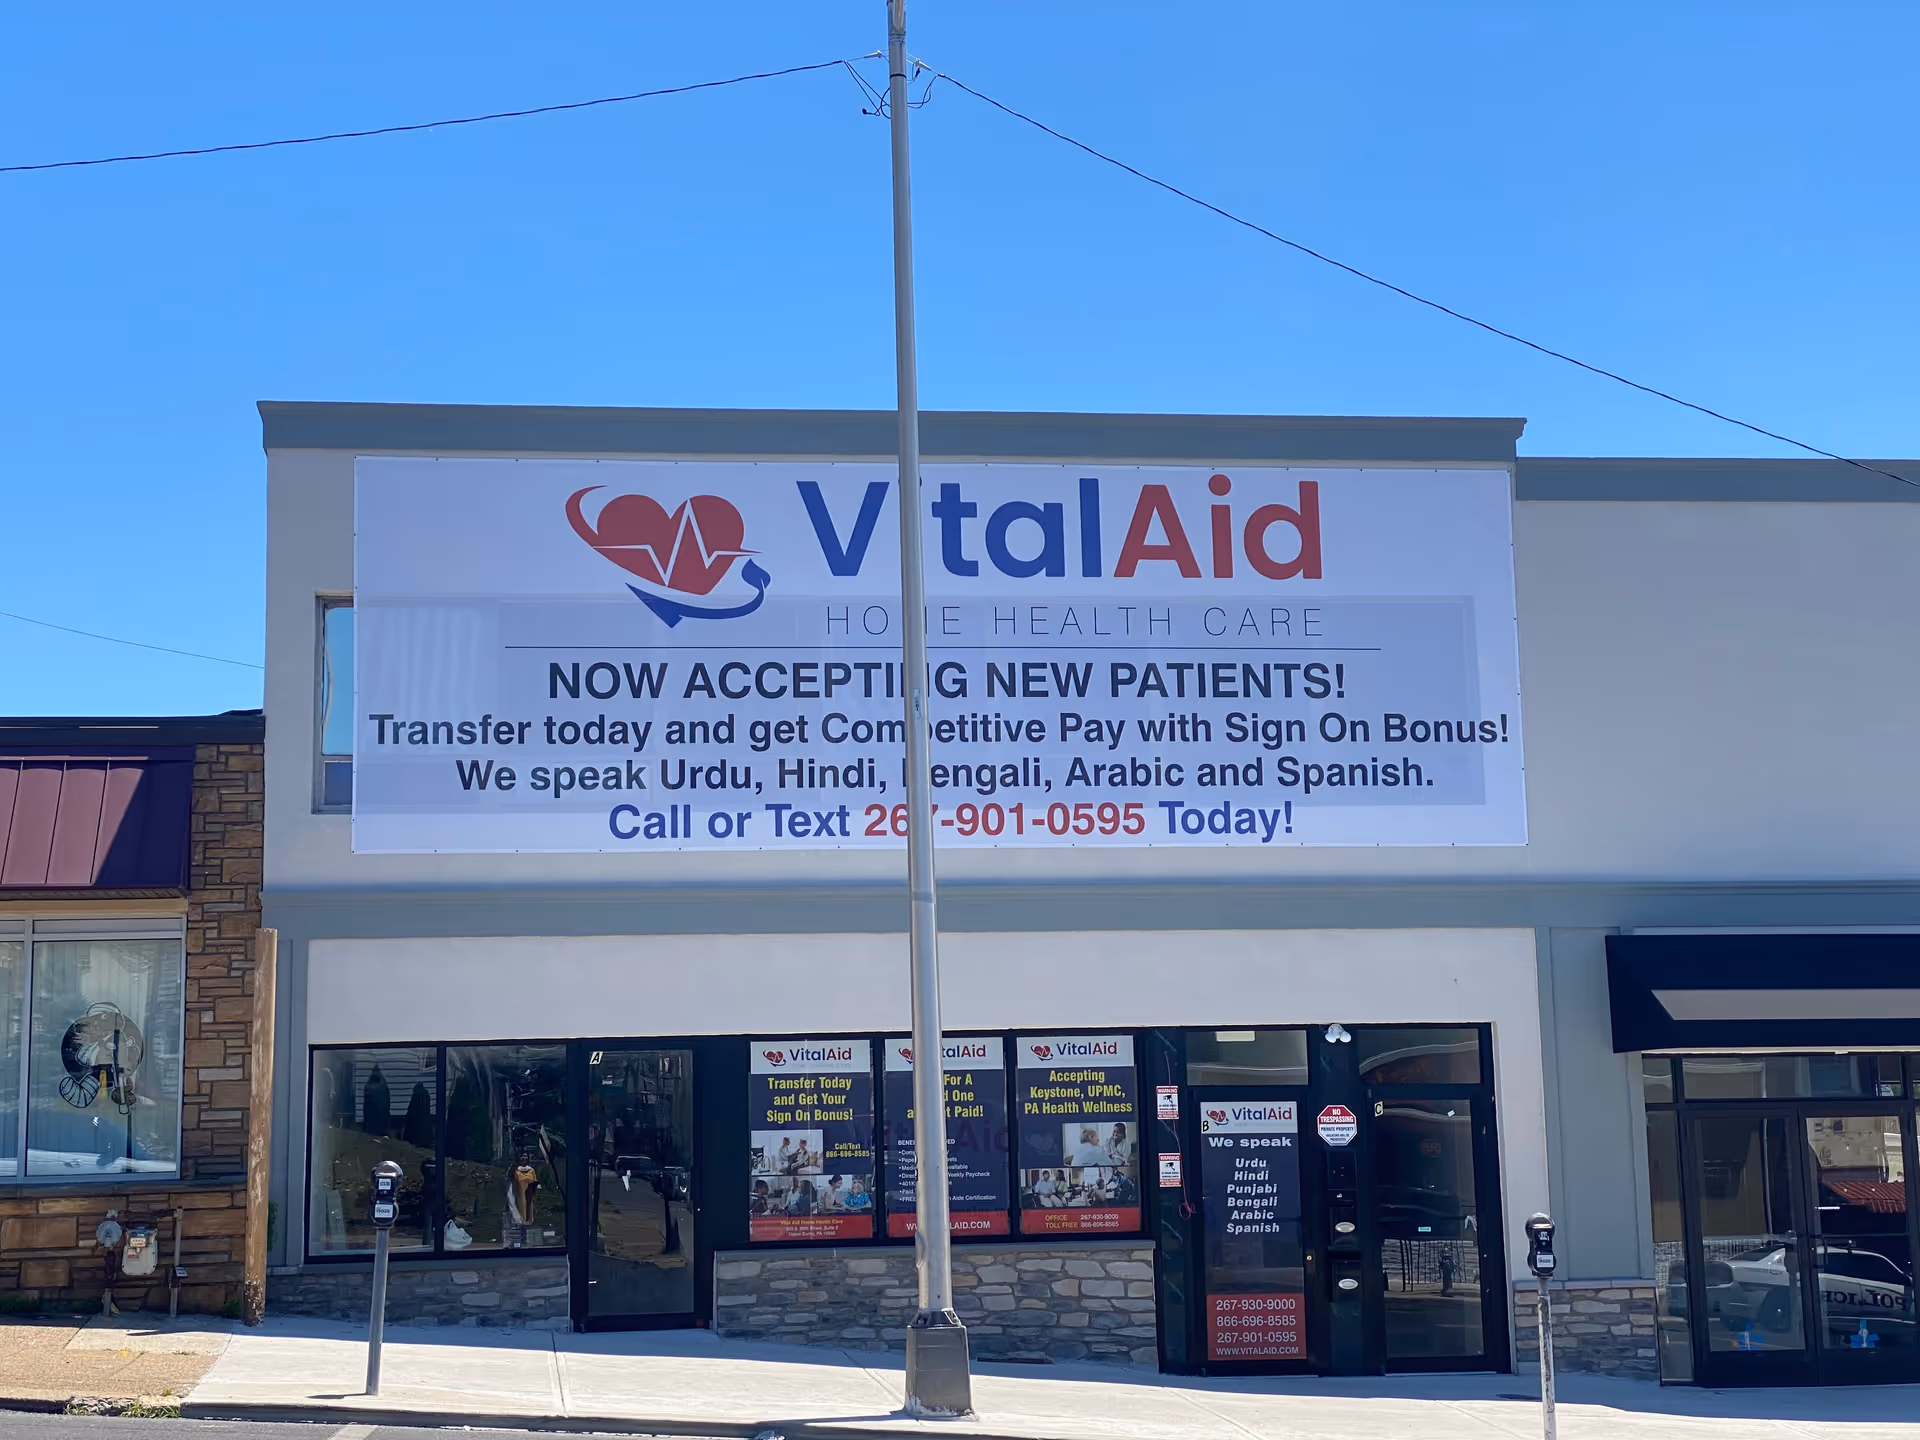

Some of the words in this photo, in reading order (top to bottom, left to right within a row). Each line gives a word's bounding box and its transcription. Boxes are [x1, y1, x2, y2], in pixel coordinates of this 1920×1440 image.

[797, 474, 1322, 580] VtalAid
[826, 605, 961, 635] HOE
[994, 606, 1171, 636] HEALTH
[1203, 607, 1323, 637] CARE
[549, 661, 668, 700] NOW
[683, 661, 968, 700] ACCEPTIG
[986, 662, 1094, 699] NEW
[1110, 662, 1345, 699] PATIENTS!
[369, 713, 532, 746] Transfer
[543, 713, 653, 752] today
[665, 713, 735, 745] and
[748, 715, 809, 751] get
[821, 712, 1046, 745] Cometitive
[1060, 712, 1126, 750] Pay
[1137, 712, 1212, 742] with
[1225, 712, 1306, 750] Sign
[1318, 712, 1370, 743] On
[1384, 713, 1509, 743] Bonus!
[456, 759, 516, 790] We
[529, 758, 647, 798] speak
[660, 757, 763, 796] Urdu,
[778, 757, 887, 795] Hindi,
[902, 756, 1052, 796] engali,
[1064, 757, 1185, 788] Arabic
[1196, 757, 1264, 787] and
[1277, 756, 1434, 794] Spanish.
[608, 803, 691, 841] Call
[707, 811, 752, 840] or
[765, 803, 850, 839] Text
[864, 802, 1146, 837] 26-901-0595
[1158, 800, 1295, 843] Today!
[789, 1047, 852, 1061] VitalAid
[942, 1044, 986, 1058] talAid
[1056, 1041, 1118, 1055] VitalAid
[591, 1052, 600, 1064] A
[944, 1074, 962, 1086] For
[965, 1073, 973, 1085] A
[1049, 1070, 1105, 1083] Accepting
[767, 1077, 816, 1089] Transfer
[819, 1076, 852, 1091] Today
[773, 1093, 795, 1105] and
[798, 1093, 819, 1105] Get
[821, 1092, 847, 1105] Your
[952, 1089, 975, 1102] One
[1030, 1086, 1084, 1101] Keystone,
[1088, 1084, 1126, 1098] UPMC,
[955, 1105, 984, 1118] Paid!
[1024, 1102, 1039, 1114] PA
[1042, 1101, 1079, 1114] Health
[1082, 1101, 1133, 1113] Wellness
[1232, 1107, 1292, 1120] VitalAid
[1332, 1108, 1341, 1116] NO
[766, 1109, 792, 1124] Sign
[795, 1109, 811, 1122] On
[814, 1108, 853, 1121] Bonus!
[1320, 1115, 1354, 1123] TRESPASSING
[1202, 1120, 1210, 1132] B
[1208, 1137, 1234, 1147] We
[1240, 1137, 1292, 1149] speak
[1235, 1158, 1267, 1168] Urdu
[1234, 1170, 1269, 1181] Hindi
[1226, 1184, 1277, 1196] Punjabi
[1227, 1197, 1278, 1209] Bengali
[1231, 1210, 1275, 1220] Arabic
[1226, 1223, 1280, 1236] Spanish
[1216, 1298, 1296, 1311] 267-930-9000
[1216, 1315, 1296, 1327] 866-696-8585
[1217, 1331, 1297, 1343] 267-901-0595
[1215, 1346, 1299, 1356] WWW.VITALAID.COM
